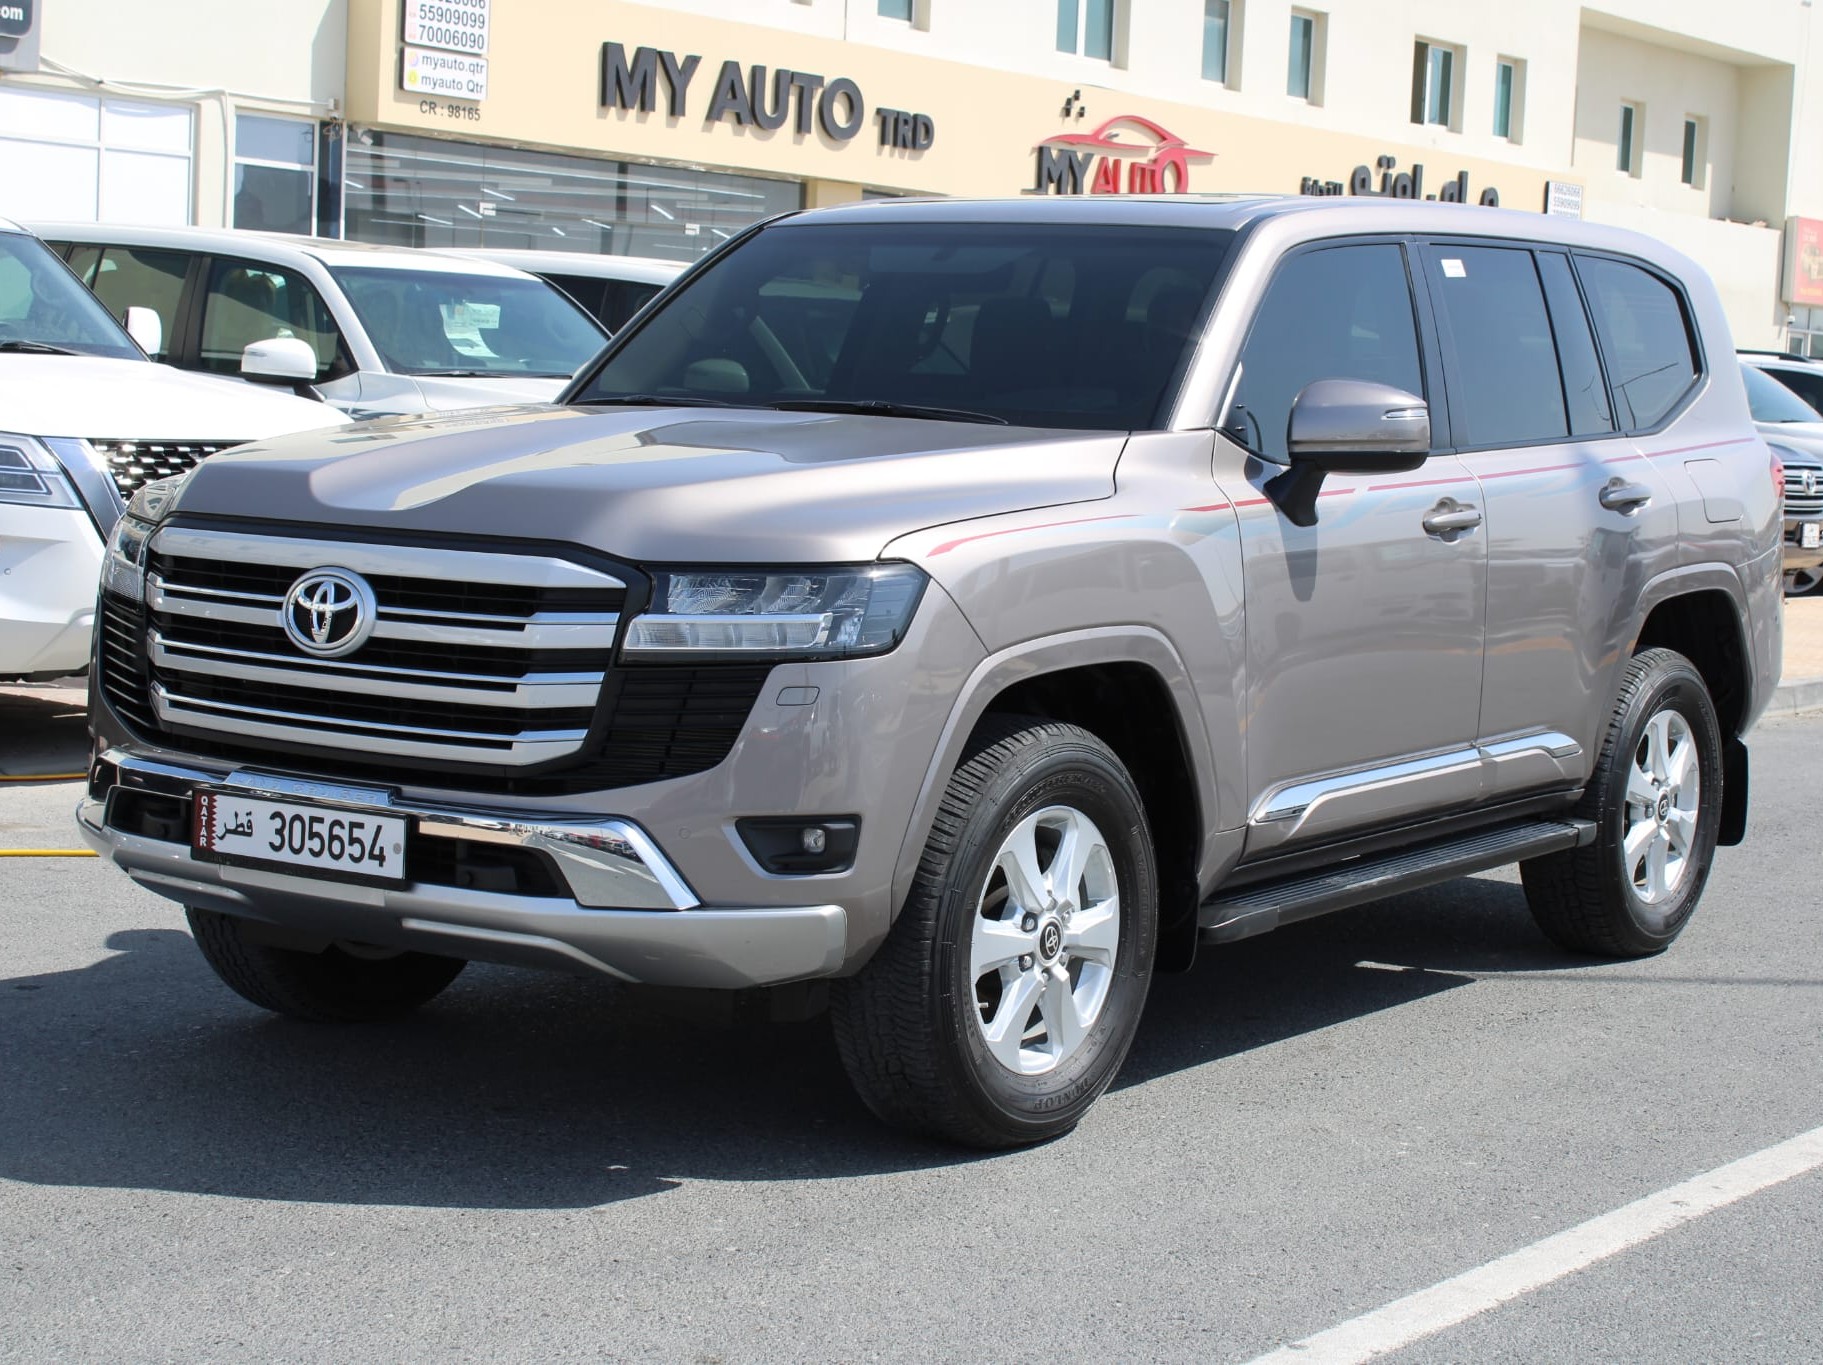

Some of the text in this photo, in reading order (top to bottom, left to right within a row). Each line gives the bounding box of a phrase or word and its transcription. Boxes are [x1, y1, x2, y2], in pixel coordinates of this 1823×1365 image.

[0, 5, 24, 21] om
[419, 4, 486, 29] 55909099
[418, 24, 485, 50] 70006090
[421, 55, 485, 76] myauto.qtr
[420, 75, 484, 94] myauto Qtr
[599, 41, 935, 151] MY AUTO TRD
[419, 100, 437, 115] CR
[447, 104, 481, 121] 98165
[200, 795, 209, 847] QATAR
[216, 811, 386, 867] قطر 305654
